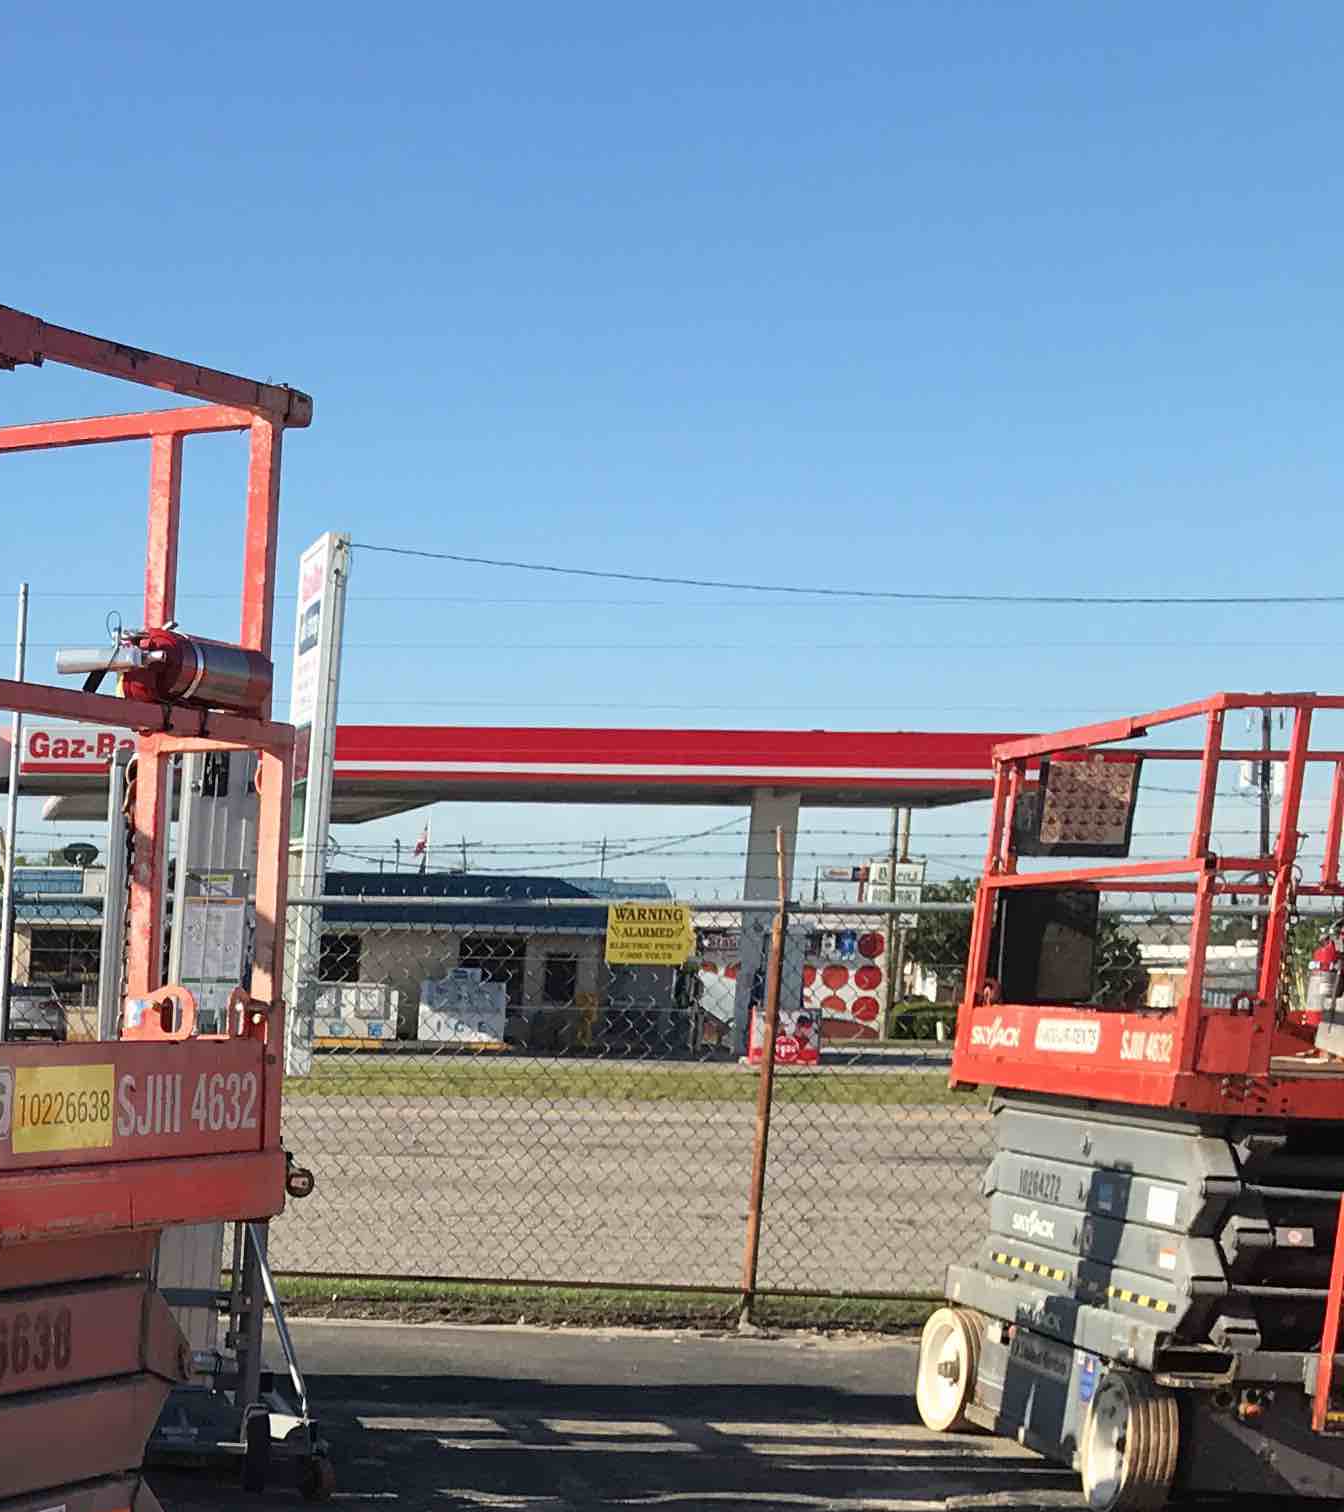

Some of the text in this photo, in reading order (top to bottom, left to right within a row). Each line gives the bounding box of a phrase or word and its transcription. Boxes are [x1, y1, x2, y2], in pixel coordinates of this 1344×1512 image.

[614, 907, 684, 921] WARNING
[623, 926, 674, 938] ALARMED
[970, 1016, 1022, 1049] SKYJACK
[18, 1091, 112, 1128] 10226638
[116, 1071, 257, 1137] SJIII 4632
[1011, 1209, 1056, 1240] SKYJACK
